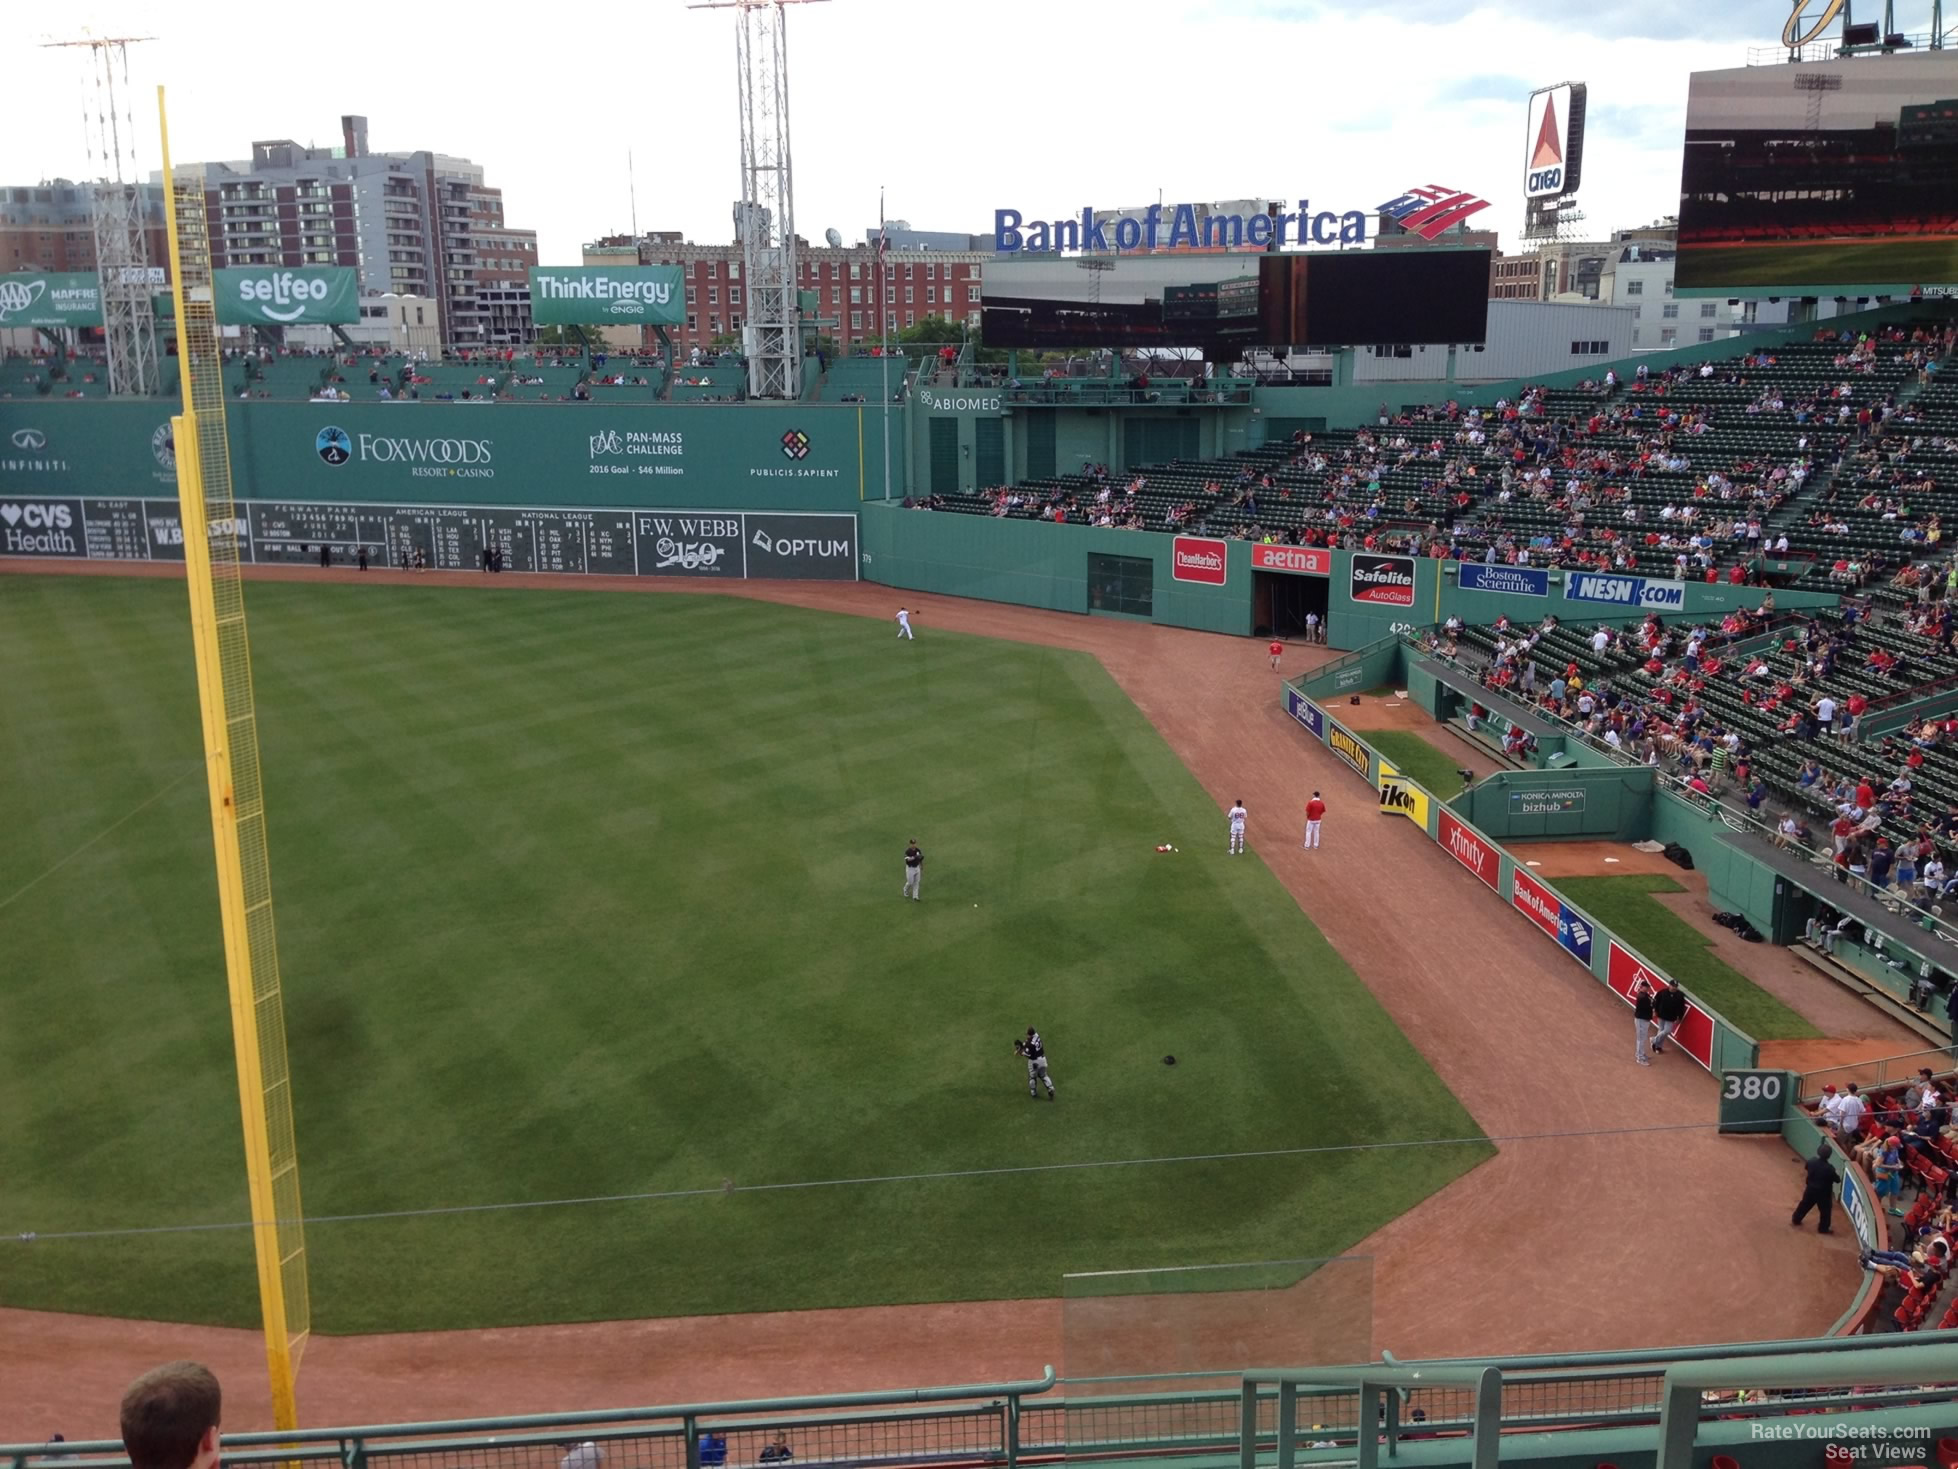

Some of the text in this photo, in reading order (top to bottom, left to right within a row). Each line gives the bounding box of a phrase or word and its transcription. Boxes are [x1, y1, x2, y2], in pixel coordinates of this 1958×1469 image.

[994, 199, 1366, 252] Bank of America
[51, 288, 98, 299] MAPFRE
[537, 276, 669, 304] ThinkEnergy
[933, 398, 1000, 410] ABIOMED
[626, 432, 683, 443] PAN-MASS
[358, 434, 492, 463] FOXWOODS
[626, 444, 683, 455] CHALLENGE
[2, 460, 67, 471] INFINITI
[412, 468, 494, 478] RESORT CASINO
[589, 465, 684, 475] 2016 Goal $46 Million
[24, 504, 73, 528] CVS
[522, 512, 559, 520] NATIONAL
[155, 527, 183, 544] W.B
[639, 518, 739, 537] F.W. WEBB
[5, 528, 76, 552] Health
[776, 538, 849, 557] OPTUM
[1263, 549, 1318, 570] aetna
[1353, 568, 1412, 585] Safelite
[1476, 574, 1535, 593] Scientific
[1485, 567, 1522, 581] Boston
[1369, 590, 1411, 602] AutoGlass
[1579, 576, 1633, 602] NESN
[1296, 696, 1315, 726] jetBlue
[1330, 728, 1356, 758] GRANITE
[1355, 744, 1369, 773] CITY
[1521, 791, 1584, 801] KONICA MINOLTA
[1522, 802, 1561, 812] bizhub
[1450, 827, 1485, 873] xfinity
[1514, 880, 1569, 935] Bank of America
[1723, 1076, 1781, 1099] 380
